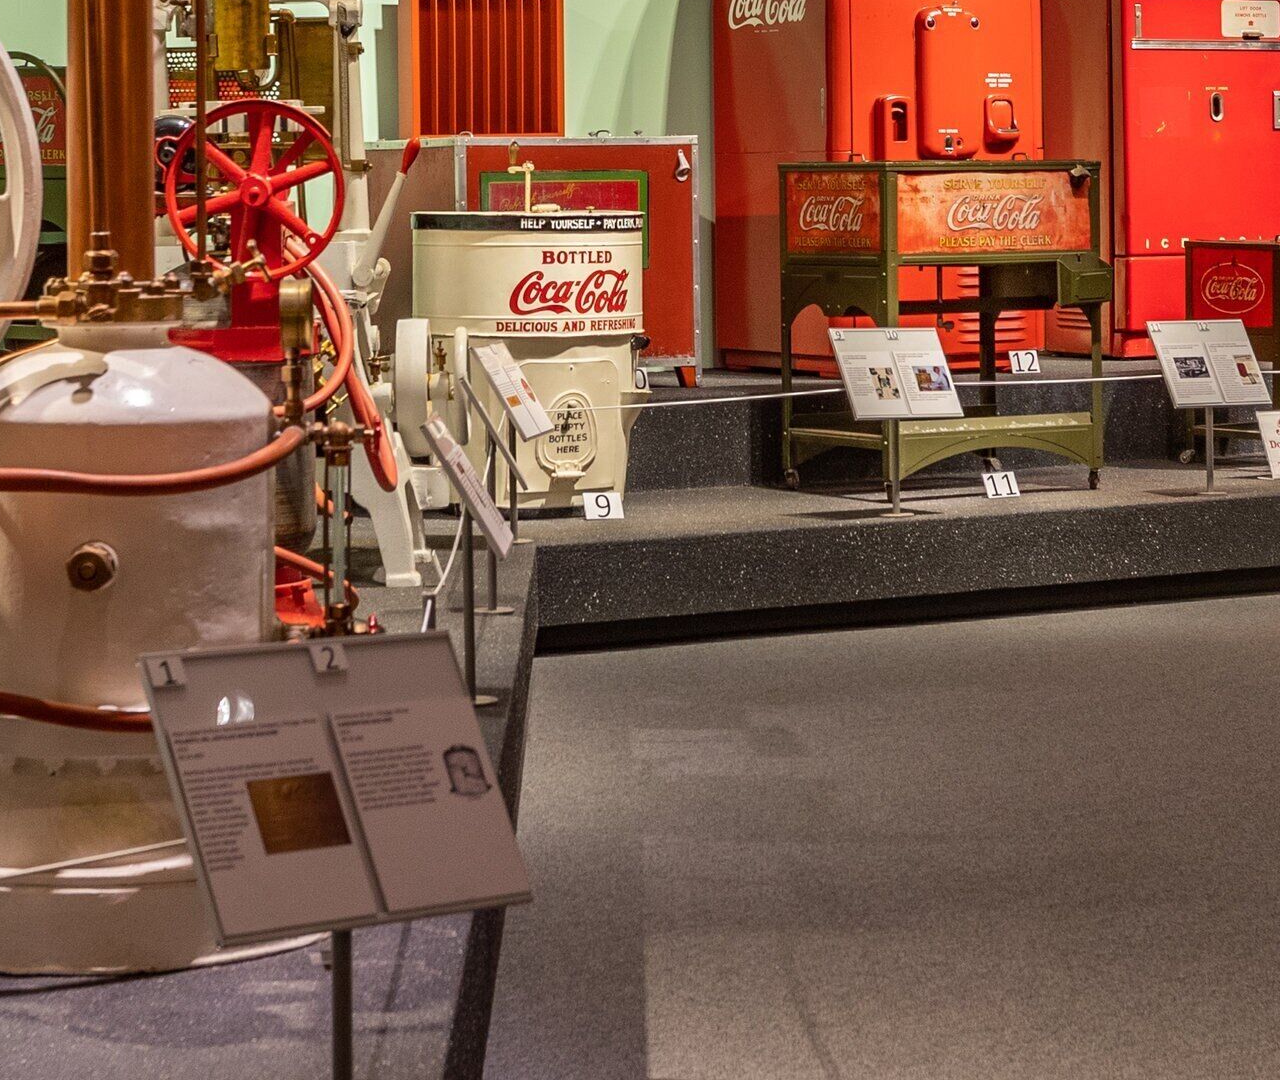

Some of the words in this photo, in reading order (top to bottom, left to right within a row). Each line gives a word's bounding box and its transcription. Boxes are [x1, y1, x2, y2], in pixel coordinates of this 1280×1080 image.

[41, 149, 66, 159] LERK
[943, 178, 982, 190] SERVE
[987, 178, 1048, 190] YOURSELF
[799, 195, 864, 232] Coca-Cola
[946, 192, 1045, 232] Coca-Cola
[520, 218, 546, 229] HELP
[550, 218, 595, 230] YOURSELF
[603, 218, 617, 229] PAY
[938, 235, 970, 248] PLEASE
[978, 235, 995, 248] PAY
[999, 235, 1016, 247] THE
[1019, 234, 1052, 246] CLERK
[541, 250, 612, 265] BOTTLED
[508, 268, 630, 316] Coca-Cola
[1205, 275, 1259, 302] Coca-Cola
[495, 321, 558, 333] DELICIOUS
[562, 320, 586, 332] AND
[590, 318, 636, 331] REFRESHING
[834, 330, 843, 340] 9
[887, 329, 898, 340] 10
[1012, 351, 1038, 372] 12
[556, 411, 583, 421] PLACE
[554, 422, 586, 432] EMPTY
[548, 432, 588, 444] BOTTLES
[556, 445, 580, 454] HERE
[986, 473, 1017, 497] 11
[595, 494, 611, 518] 9
[320, 647, 339, 671] 2
[158, 659, 177, 686] 1
